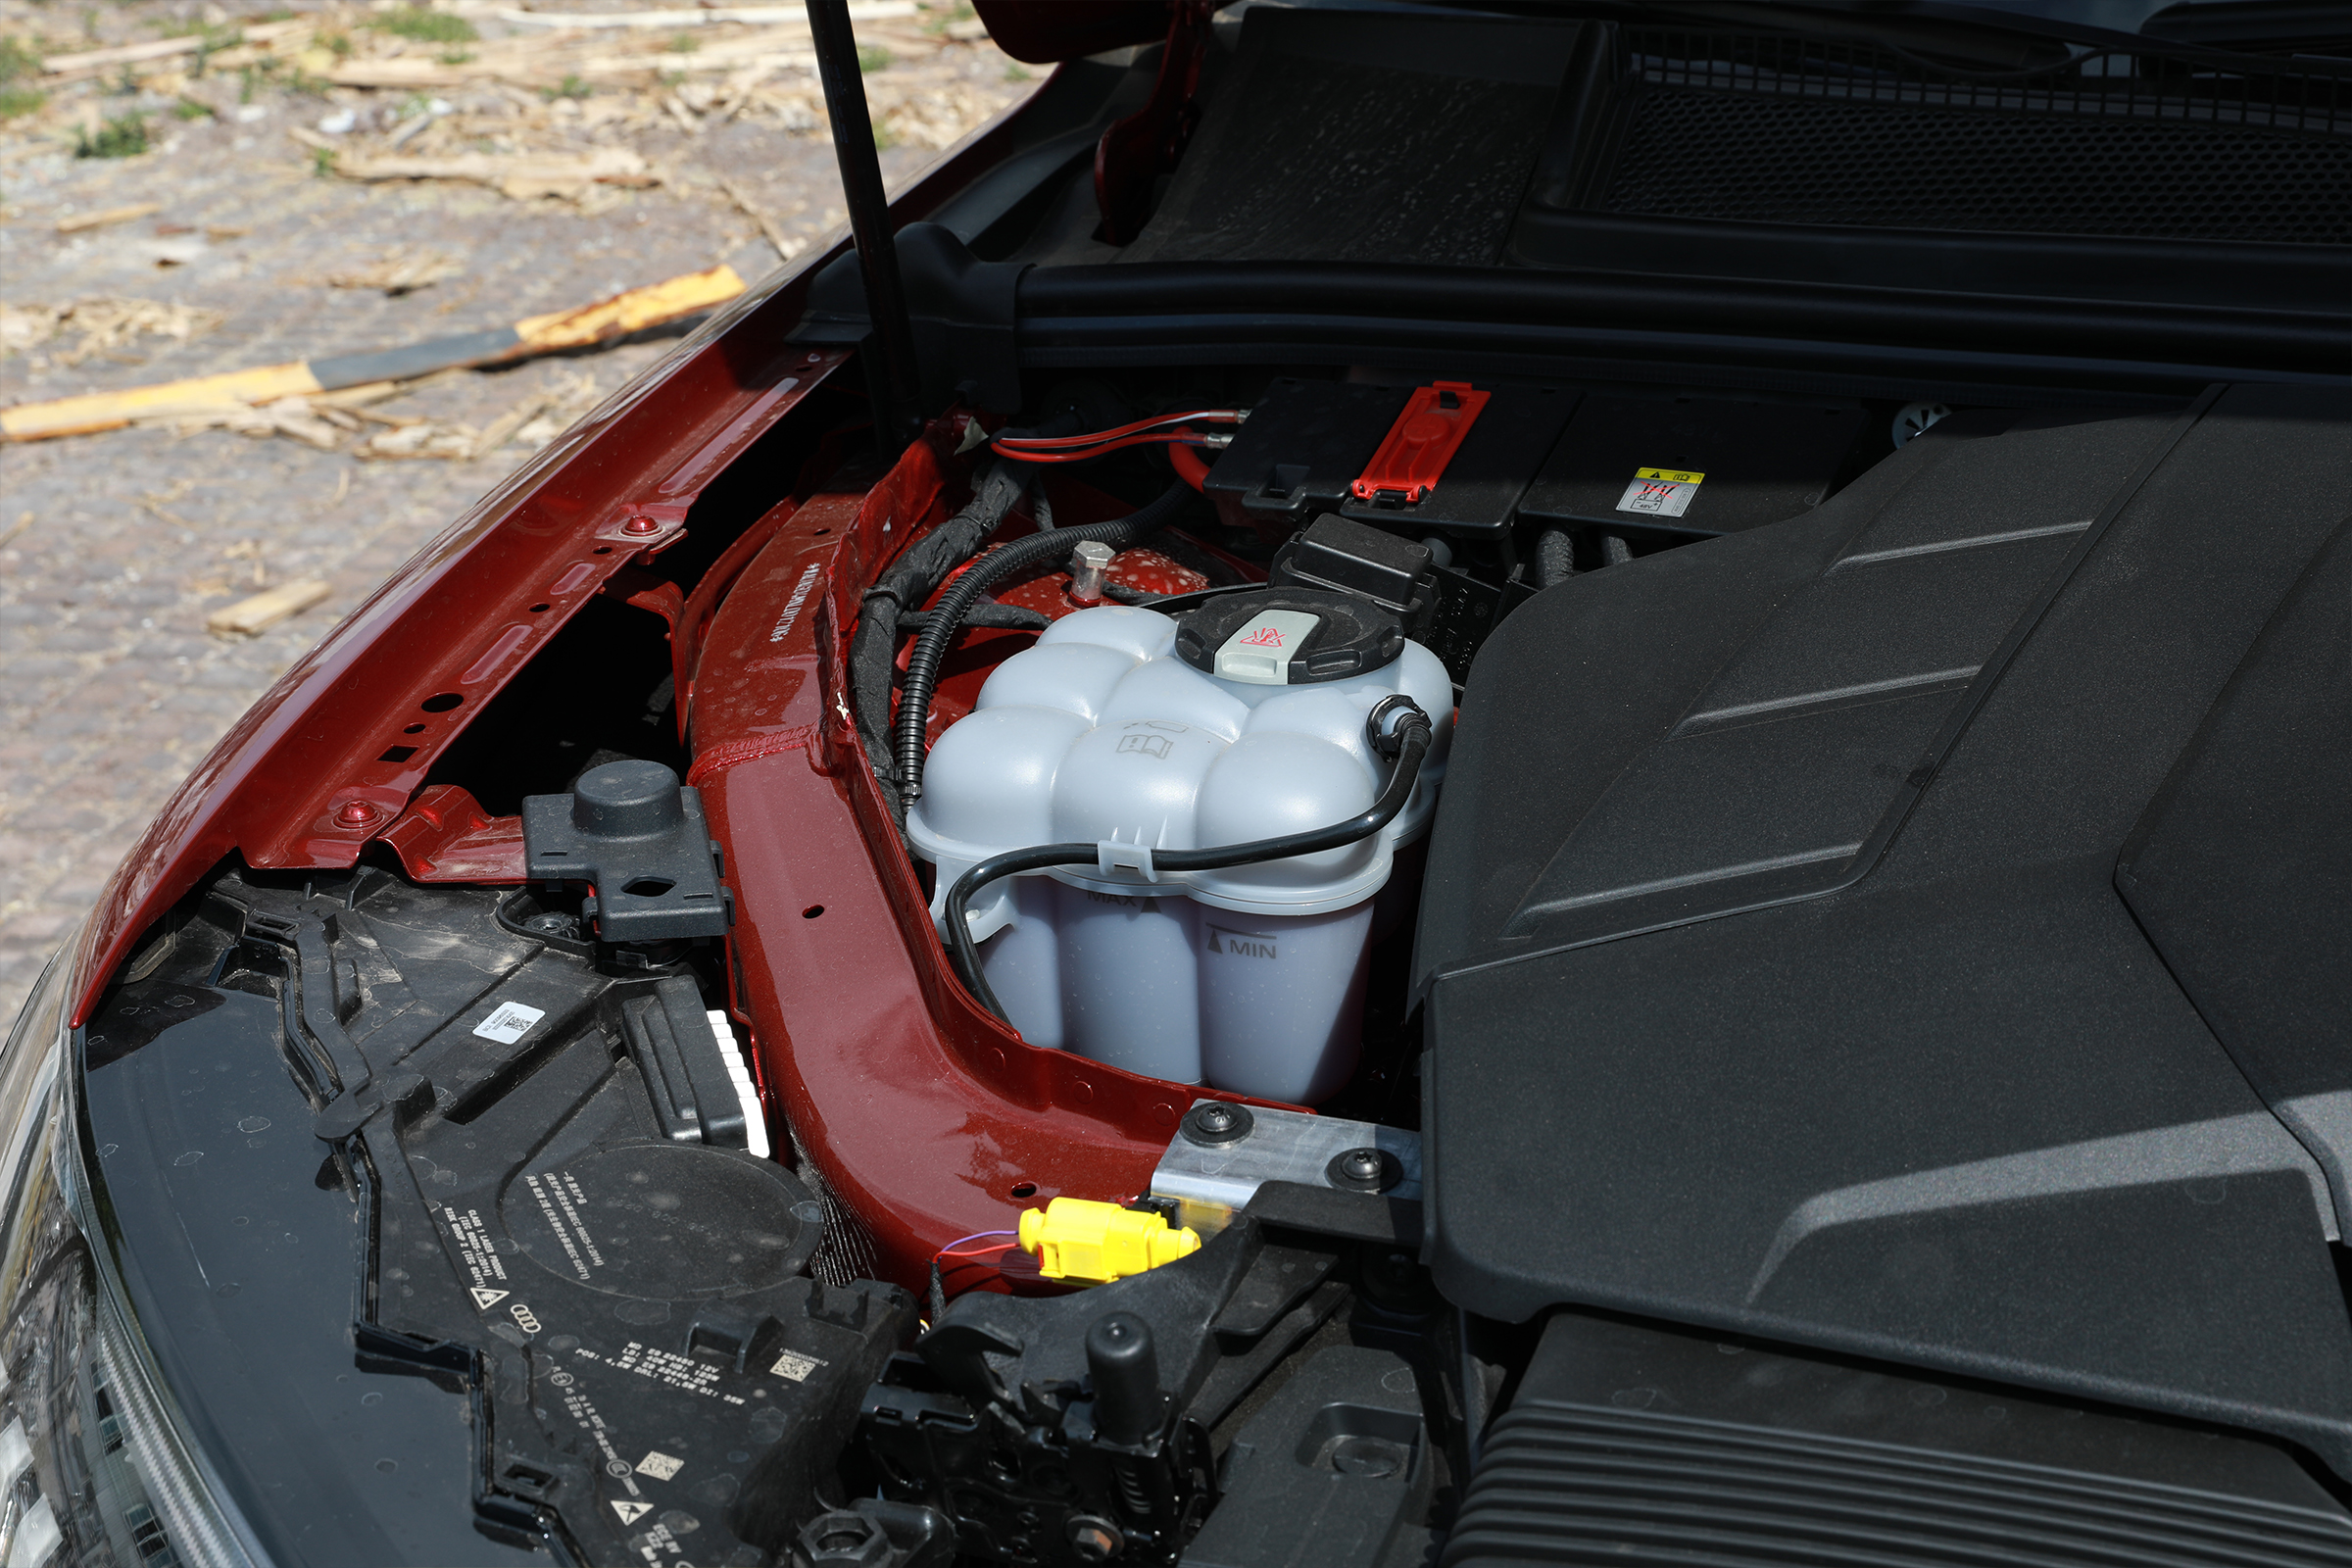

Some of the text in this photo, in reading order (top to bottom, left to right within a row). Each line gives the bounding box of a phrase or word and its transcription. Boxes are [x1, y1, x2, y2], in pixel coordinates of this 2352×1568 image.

[1087, 892, 1137, 907] MAX
[1230, 939, 1277, 958] MIN
[459, 1216, 472, 1230] (IEC
[444, 1207, 457, 1222] RISK
[462, 1250, 476, 1264] (IEC
[468, 1209, 482, 1227] CLASS
[479, 1235, 494, 1253] LASER
[489, 1254, 507, 1280] PRODUCT
[700, 1364, 719, 1373] 12V
